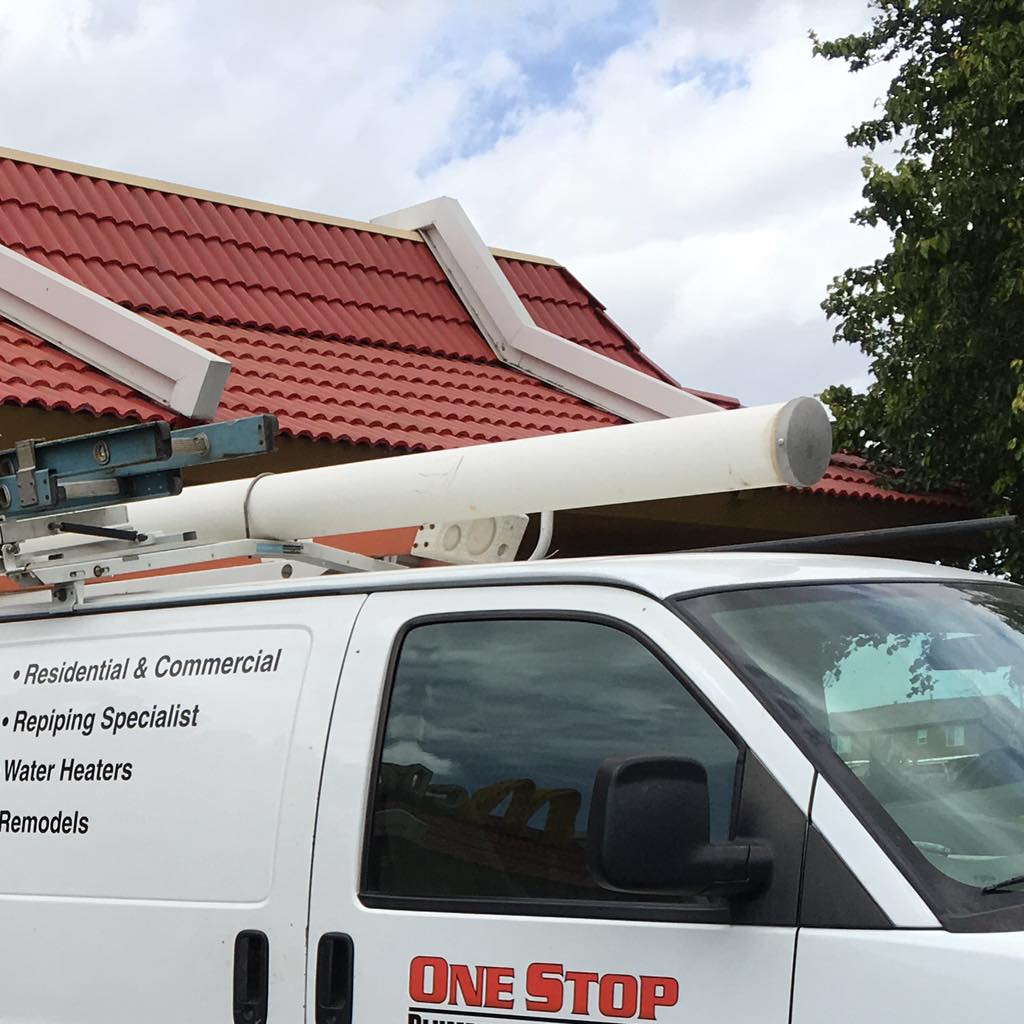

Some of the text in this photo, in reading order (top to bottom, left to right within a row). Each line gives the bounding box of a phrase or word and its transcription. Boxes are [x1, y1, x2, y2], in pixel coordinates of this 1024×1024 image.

[24, 648, 283, 685] Residential & Commercial
[13, 704, 200, 738] Repiping Specialist
[4, 758, 133, 782] Water Heaters
[408, 955, 680, 1021] ONE STOP
